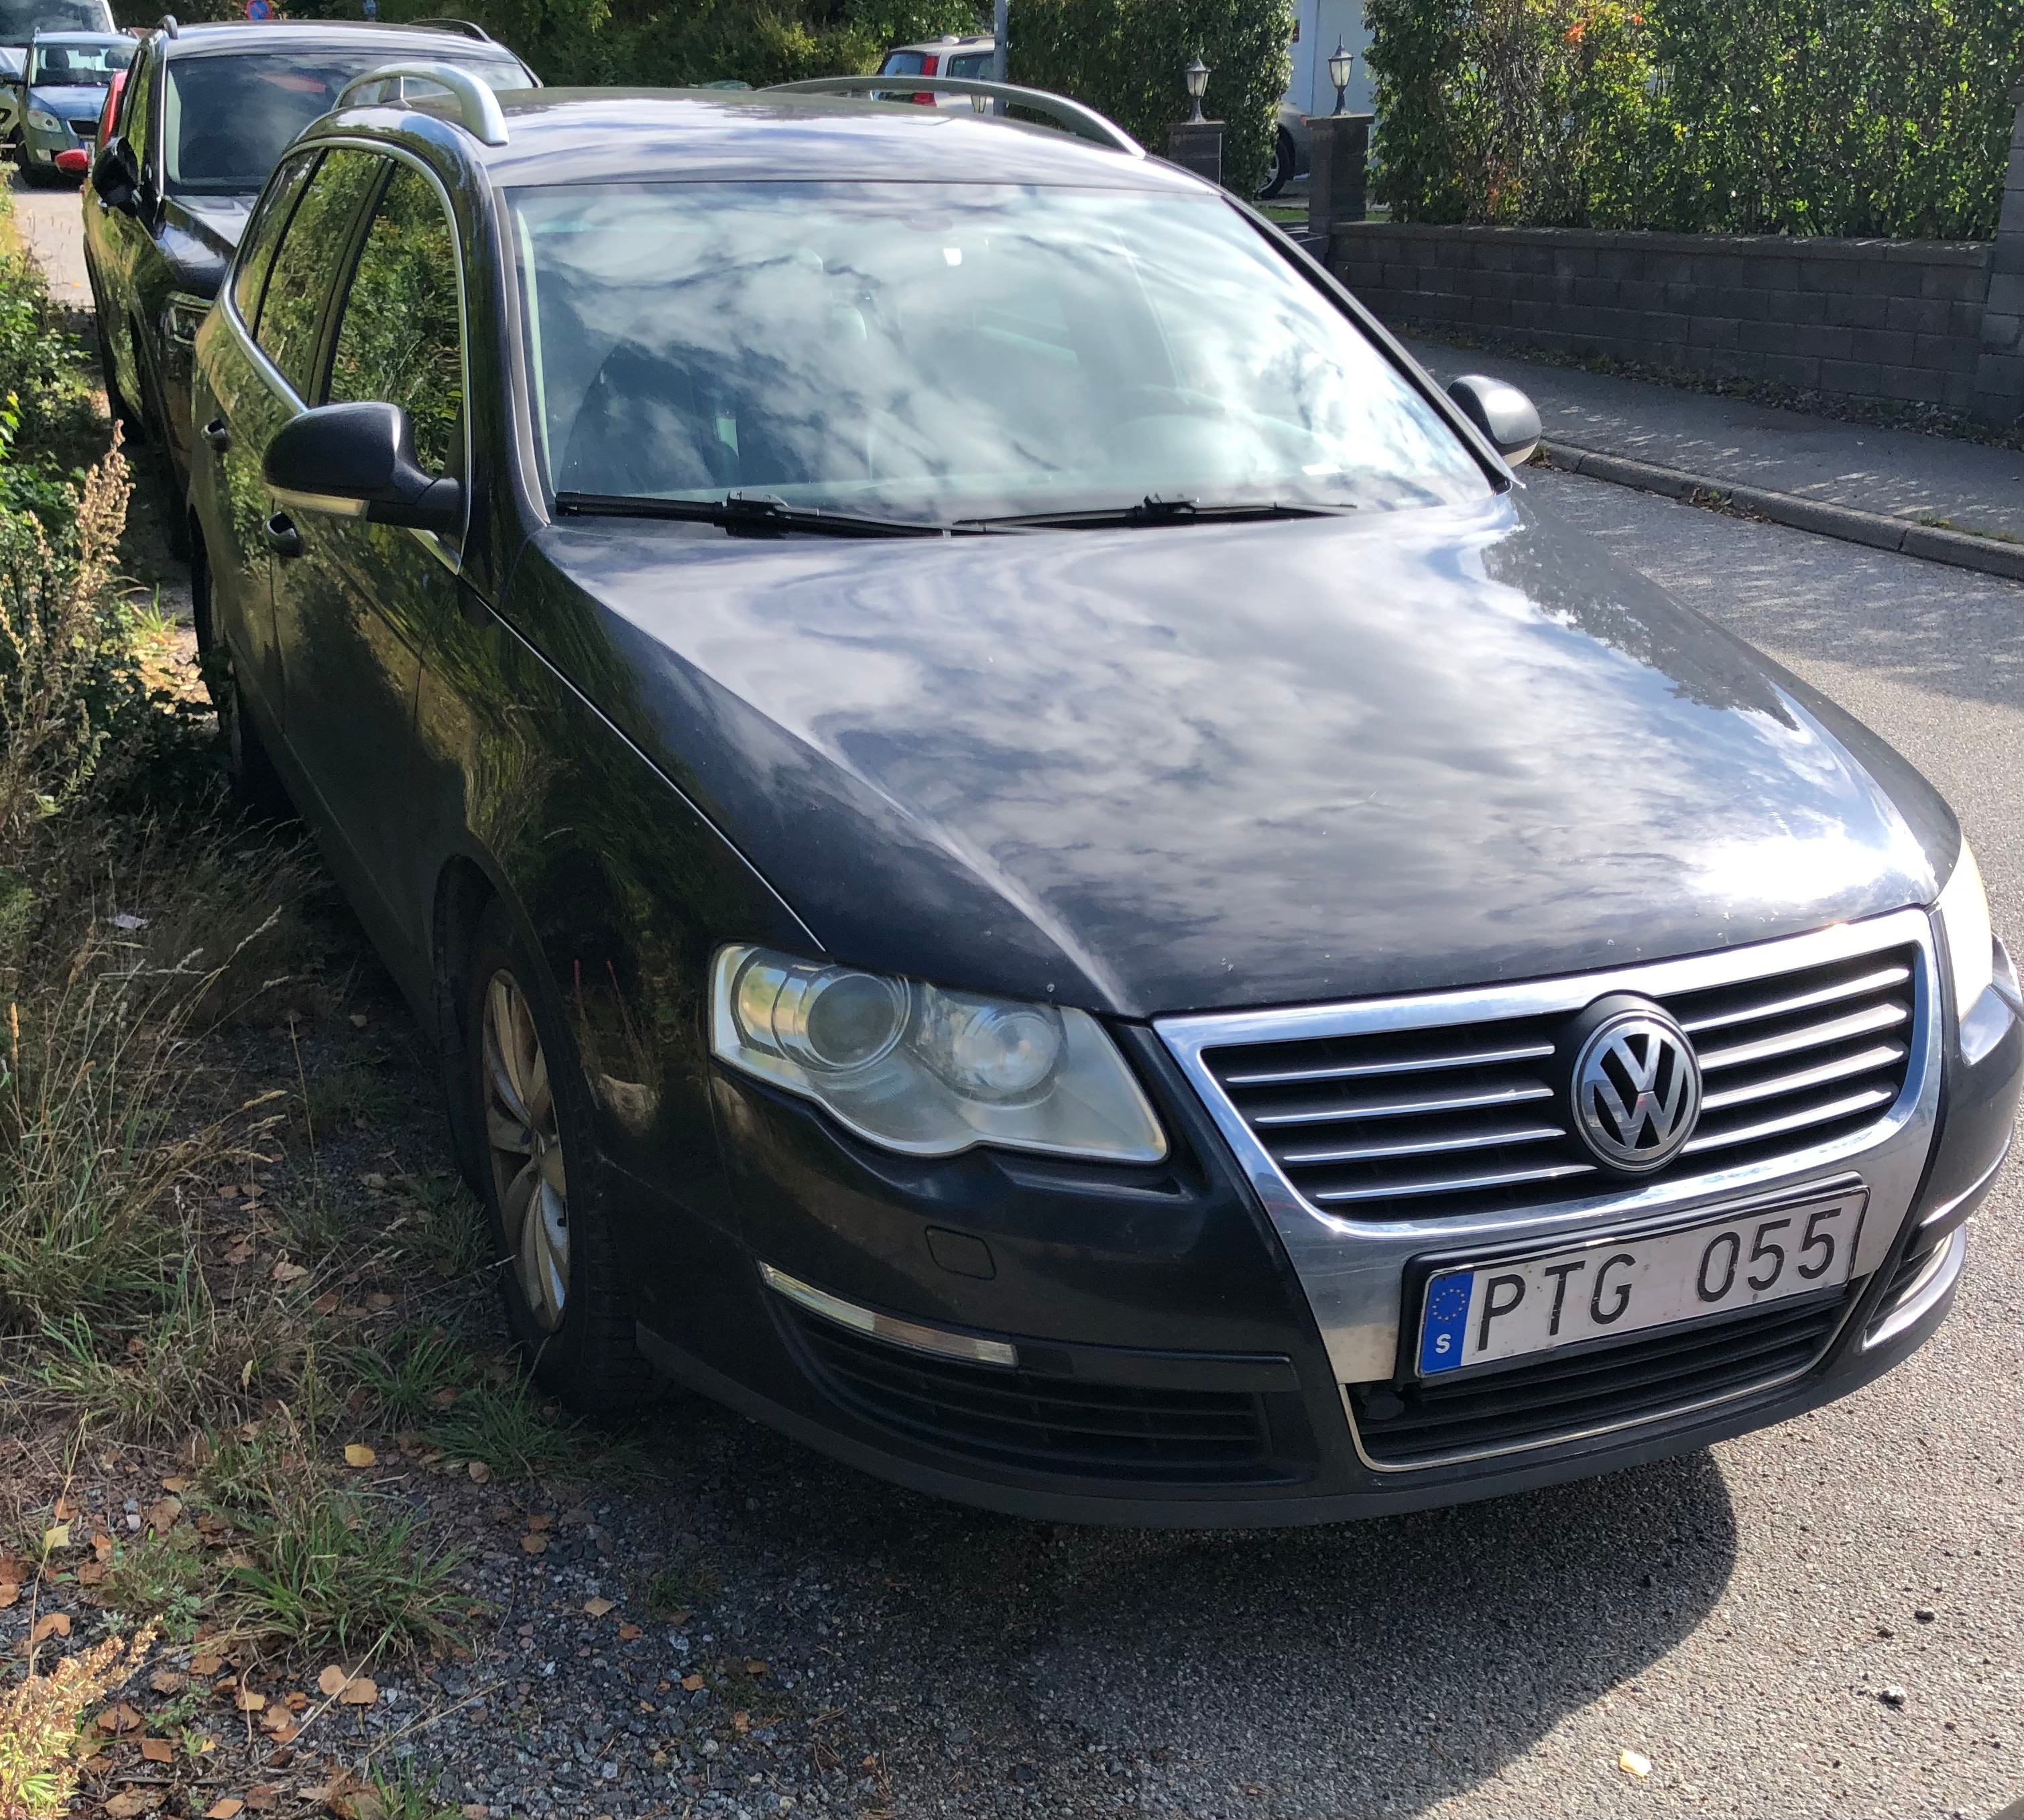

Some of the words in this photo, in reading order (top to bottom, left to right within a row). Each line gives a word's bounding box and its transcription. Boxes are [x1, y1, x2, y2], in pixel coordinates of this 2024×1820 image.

[1476, 1253, 1636, 1351] PTG
[1696, 1207, 1842, 1303] 055
[1435, 1333, 1451, 1353] S
